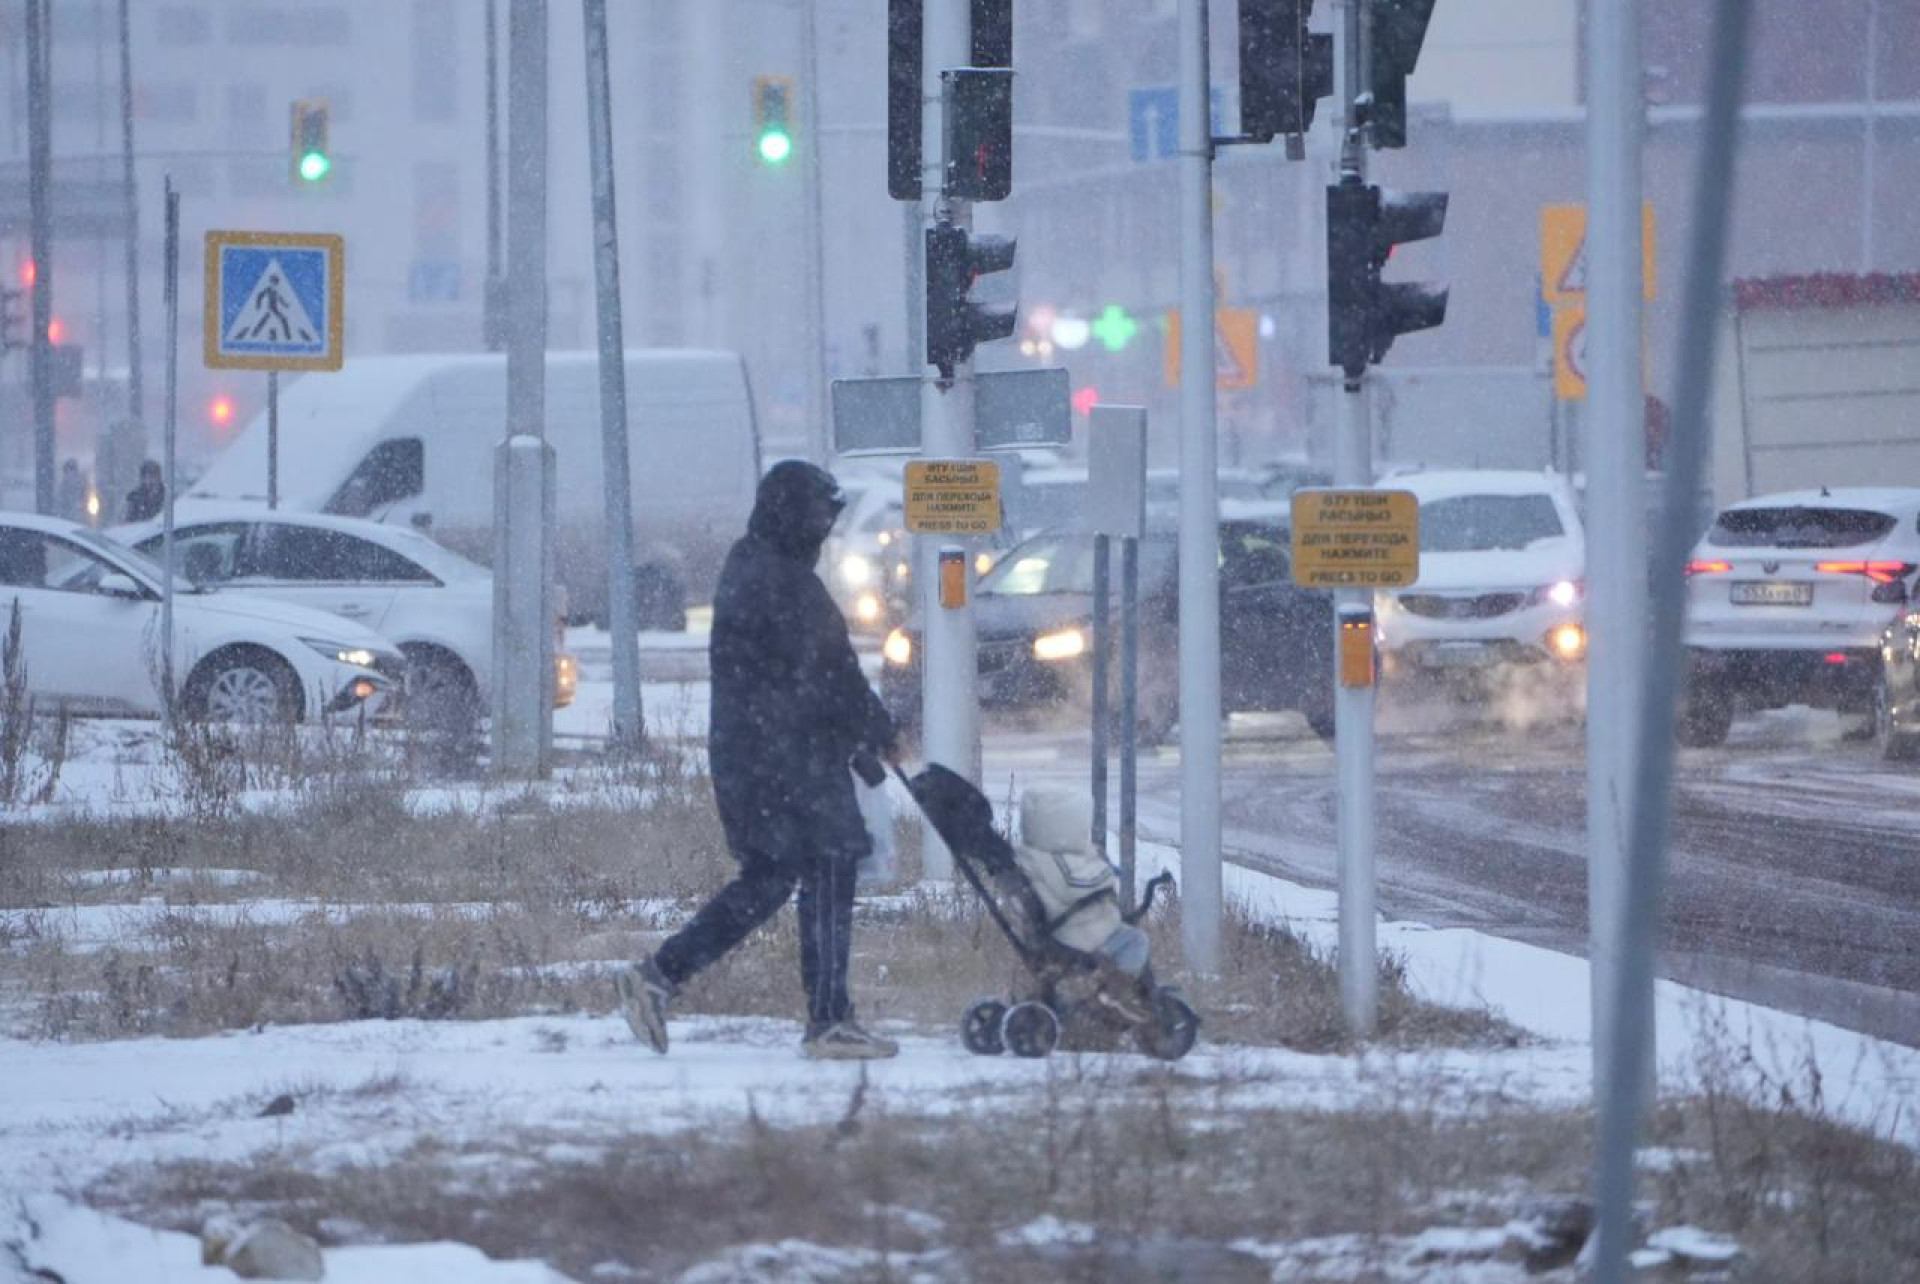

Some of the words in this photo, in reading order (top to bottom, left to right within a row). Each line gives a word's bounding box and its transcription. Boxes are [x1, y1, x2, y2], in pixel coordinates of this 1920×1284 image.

[912, 492, 934, 502] ДЛЯ
[936, 492, 992, 502] ПЕРЕХОДА
[926, 503, 977, 512] НАЖМИТЕ
[918, 521, 952, 530] PRESS
[956, 521, 969, 530] TO
[971, 521, 987, 530] GO
[1301, 533, 1331, 546] ДЛЯ
[1334, 532, 1409, 546] ПЕРЕХОДА
[1320, 548, 1389, 560] НАЖМИТЕ
[1310, 571, 1354, 583] PRESS
[1359, 571, 1378, 583] TO
[1380, 571, 1402, 583] GO
